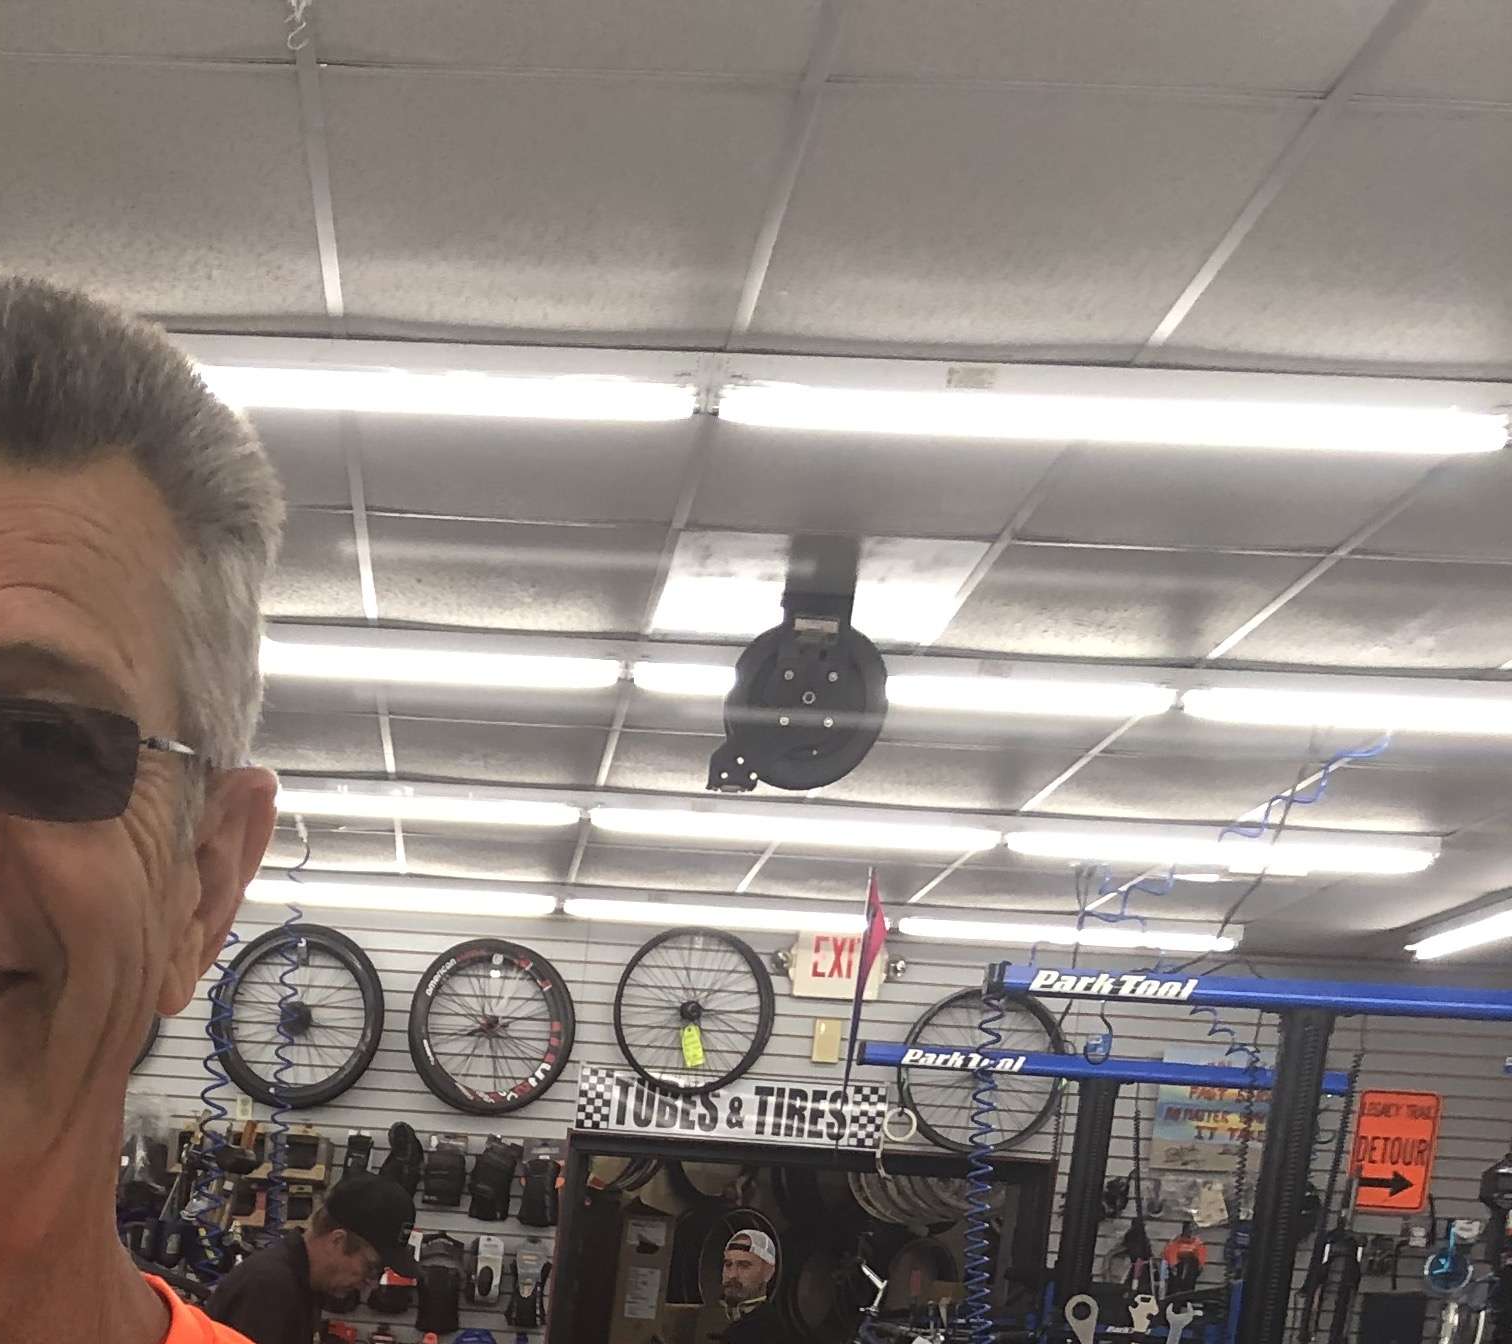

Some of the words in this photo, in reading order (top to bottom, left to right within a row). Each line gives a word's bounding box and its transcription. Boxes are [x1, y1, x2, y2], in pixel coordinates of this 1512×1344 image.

[812, 935, 861, 979] EXI
[426, 958, 456, 996] american
[1028, 970, 1119, 996] Park
[1114, 974, 1198, 1000] Tool
[901, 1049, 971, 1068] Park
[614, 1076, 720, 1132] TUBES
[726, 1096, 744, 1129] &
[754, 1085, 848, 1141] TIRES
[1355, 1135, 1428, 1166] DETOUR
